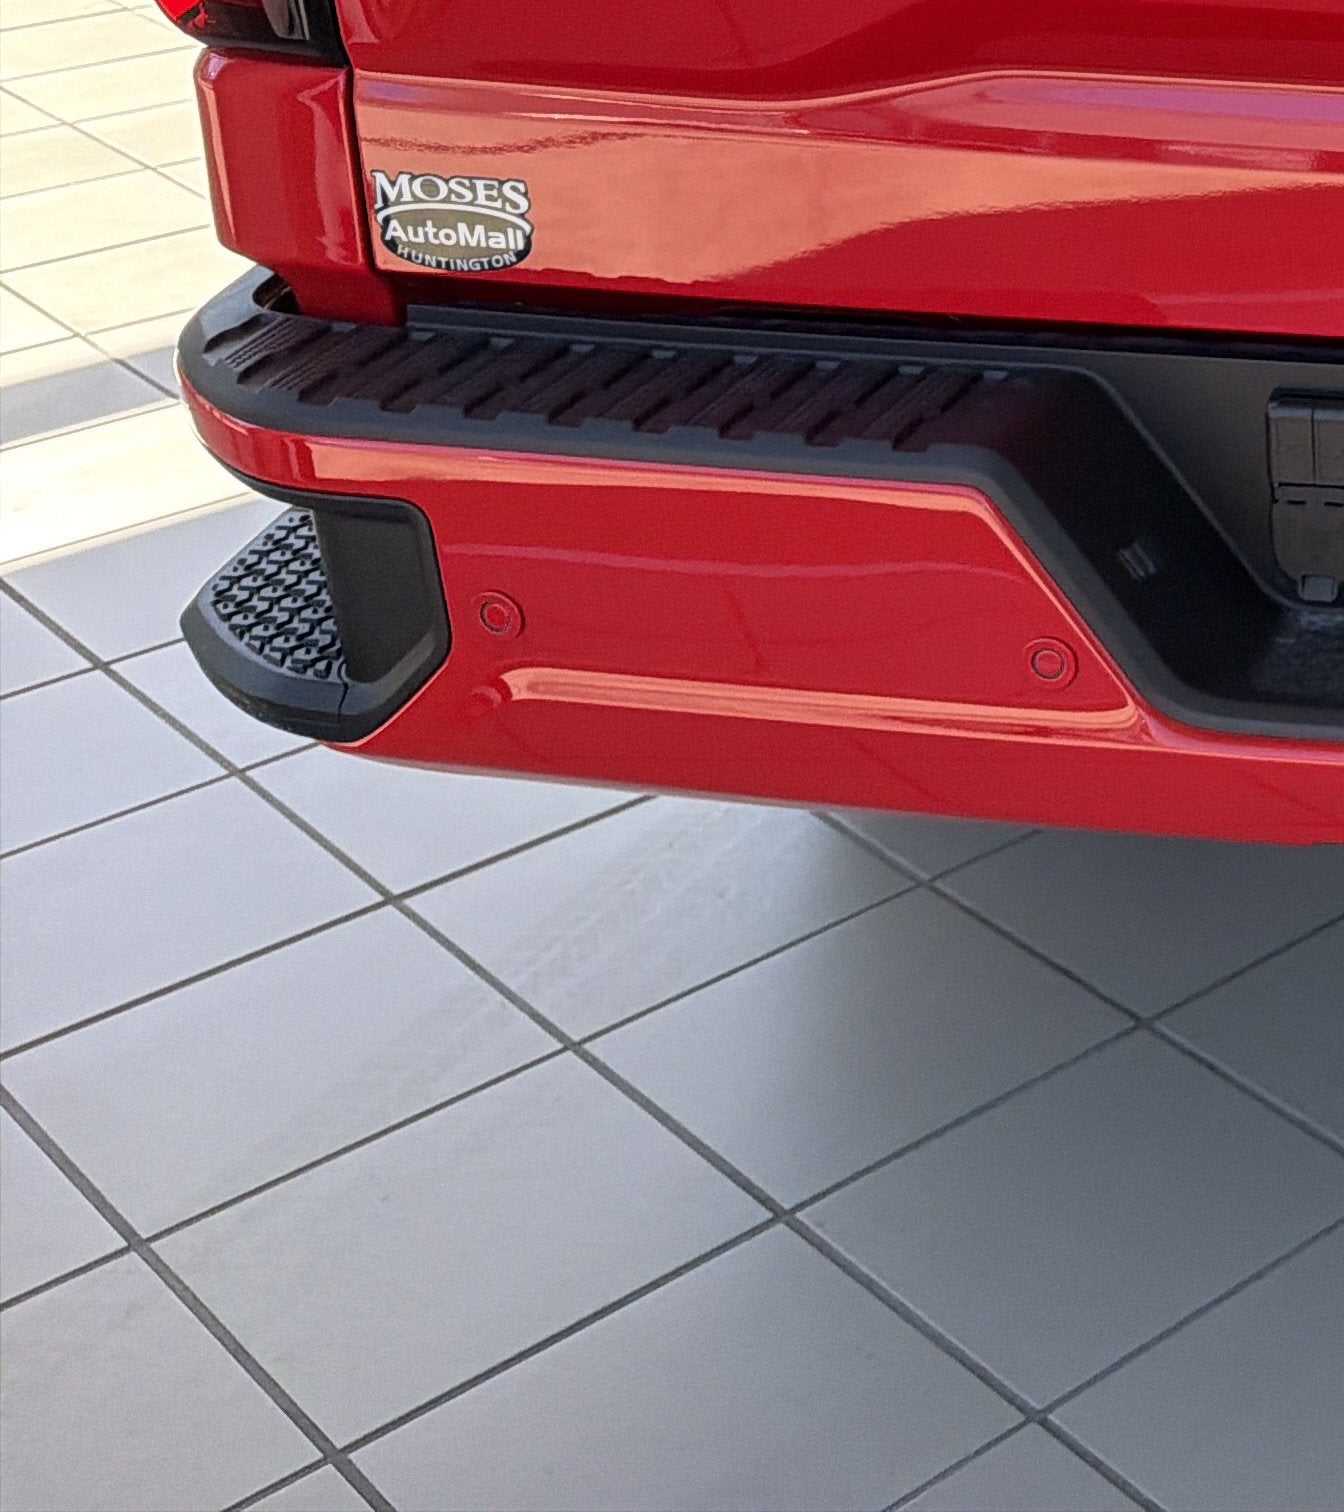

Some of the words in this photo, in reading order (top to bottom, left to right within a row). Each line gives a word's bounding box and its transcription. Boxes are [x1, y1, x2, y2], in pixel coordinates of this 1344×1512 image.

[372, 170, 530, 215] MOSES
[384, 218, 525, 251] AutoMall
[397, 244, 518, 272] HUNTINGTON
